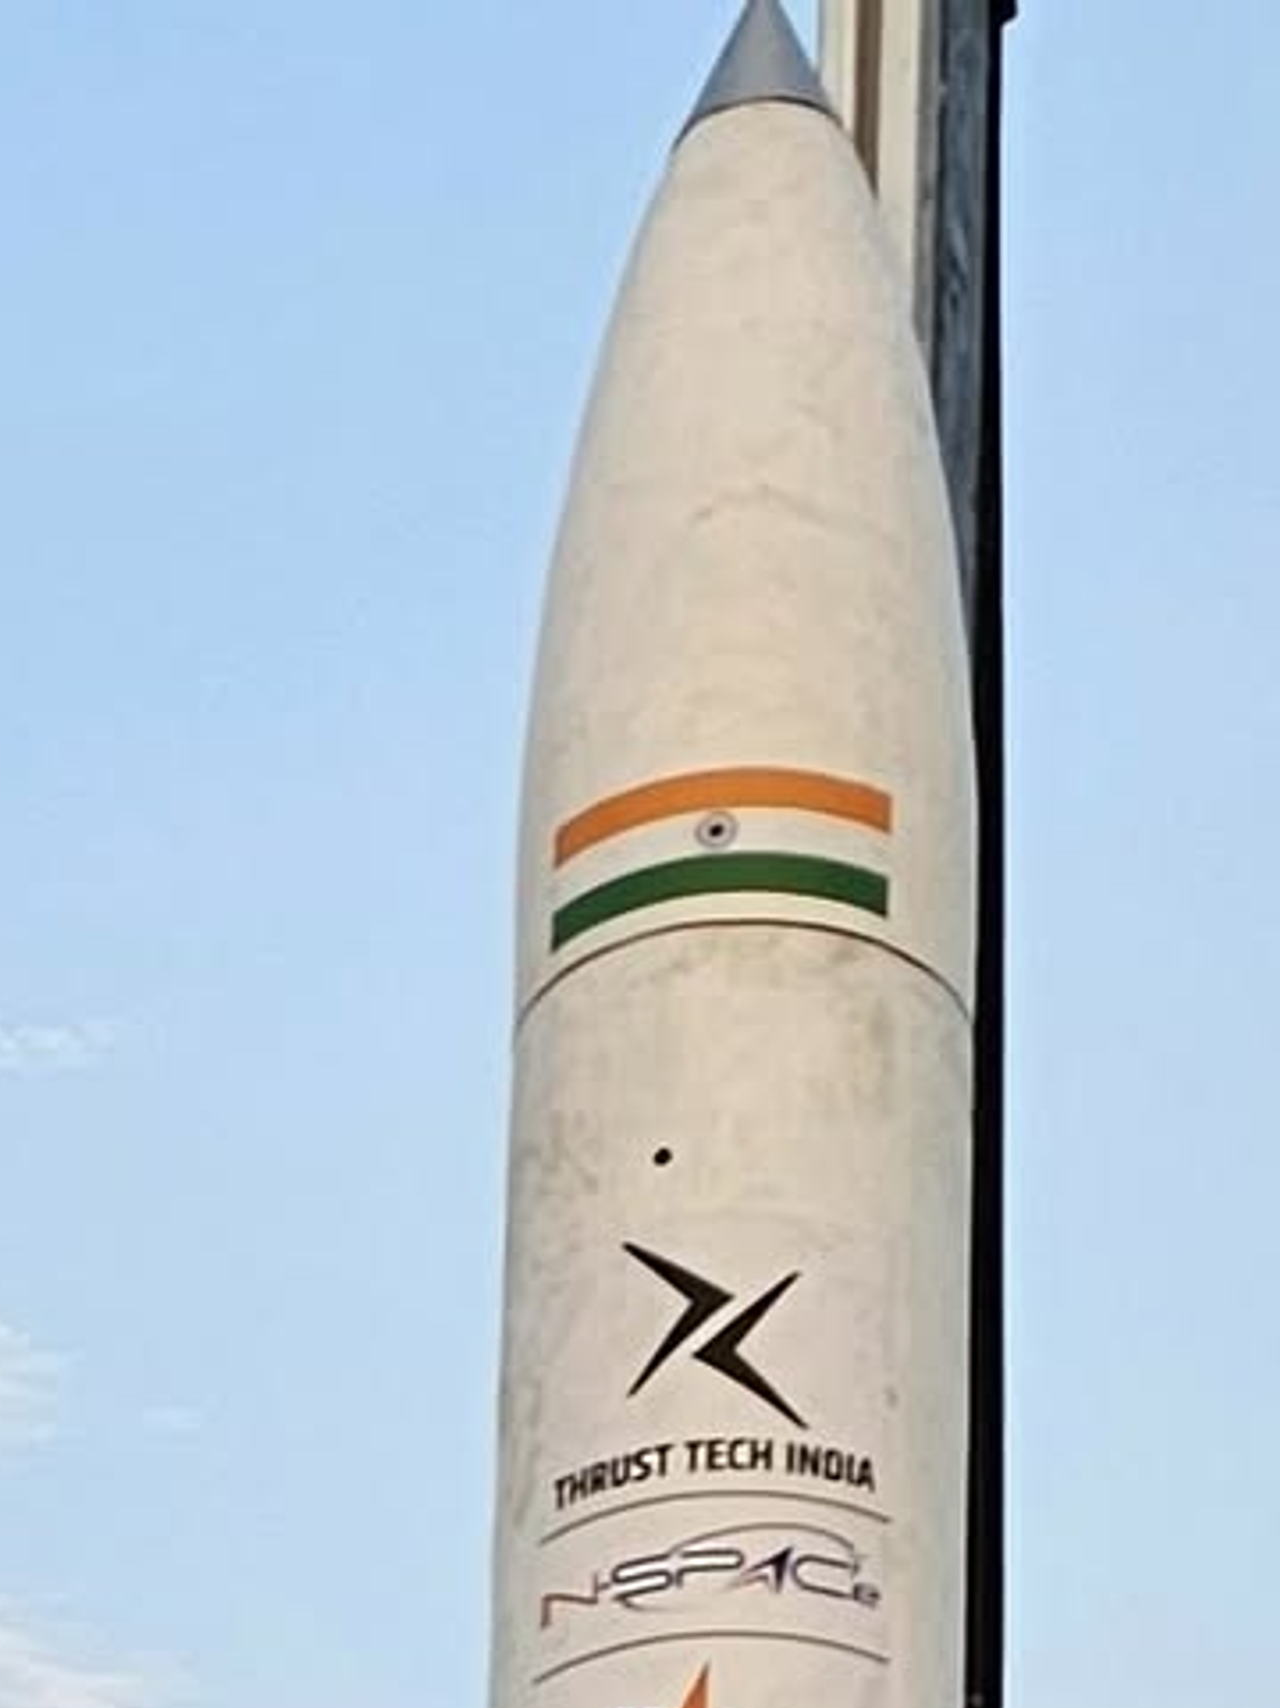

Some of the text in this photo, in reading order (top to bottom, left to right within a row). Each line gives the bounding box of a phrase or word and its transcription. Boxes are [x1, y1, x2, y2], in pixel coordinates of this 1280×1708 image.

[553, 1437, 876, 1510] THRUST TECH INDIA
